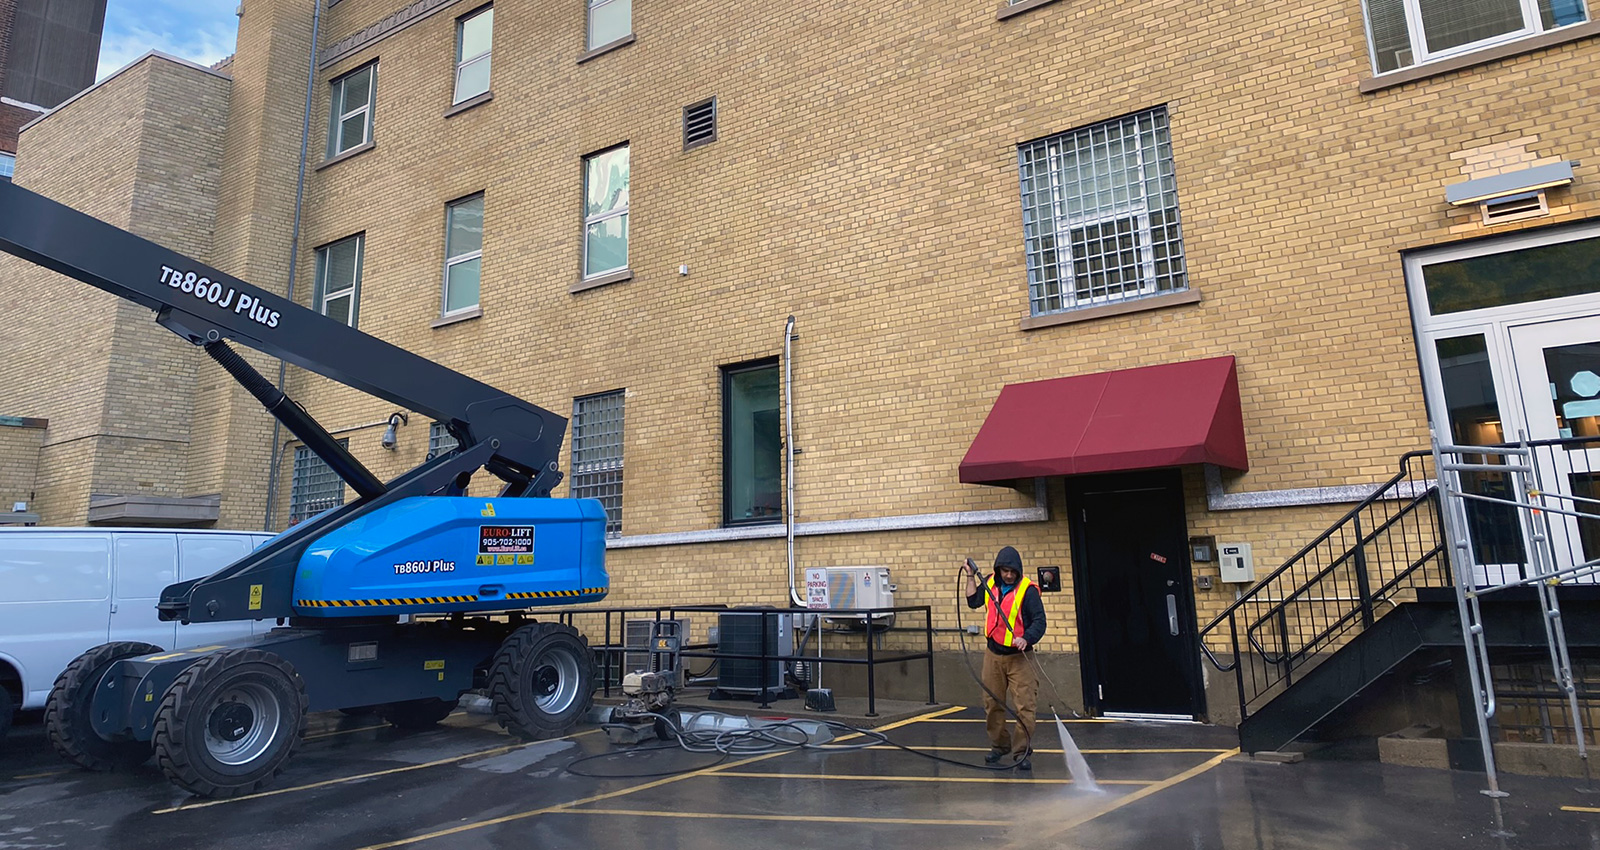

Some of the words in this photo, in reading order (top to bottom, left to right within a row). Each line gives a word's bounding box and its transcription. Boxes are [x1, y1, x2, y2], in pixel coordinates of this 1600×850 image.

[160, 265, 235, 308] TB860J
[234, 293, 281, 328] Plus
[483, 528, 531, 537] EURO-LIFT
[482, 538, 532, 546] 905-702-1000
[393, 561, 431, 574] TB860J
[432, 559, 455, 572] Plus
